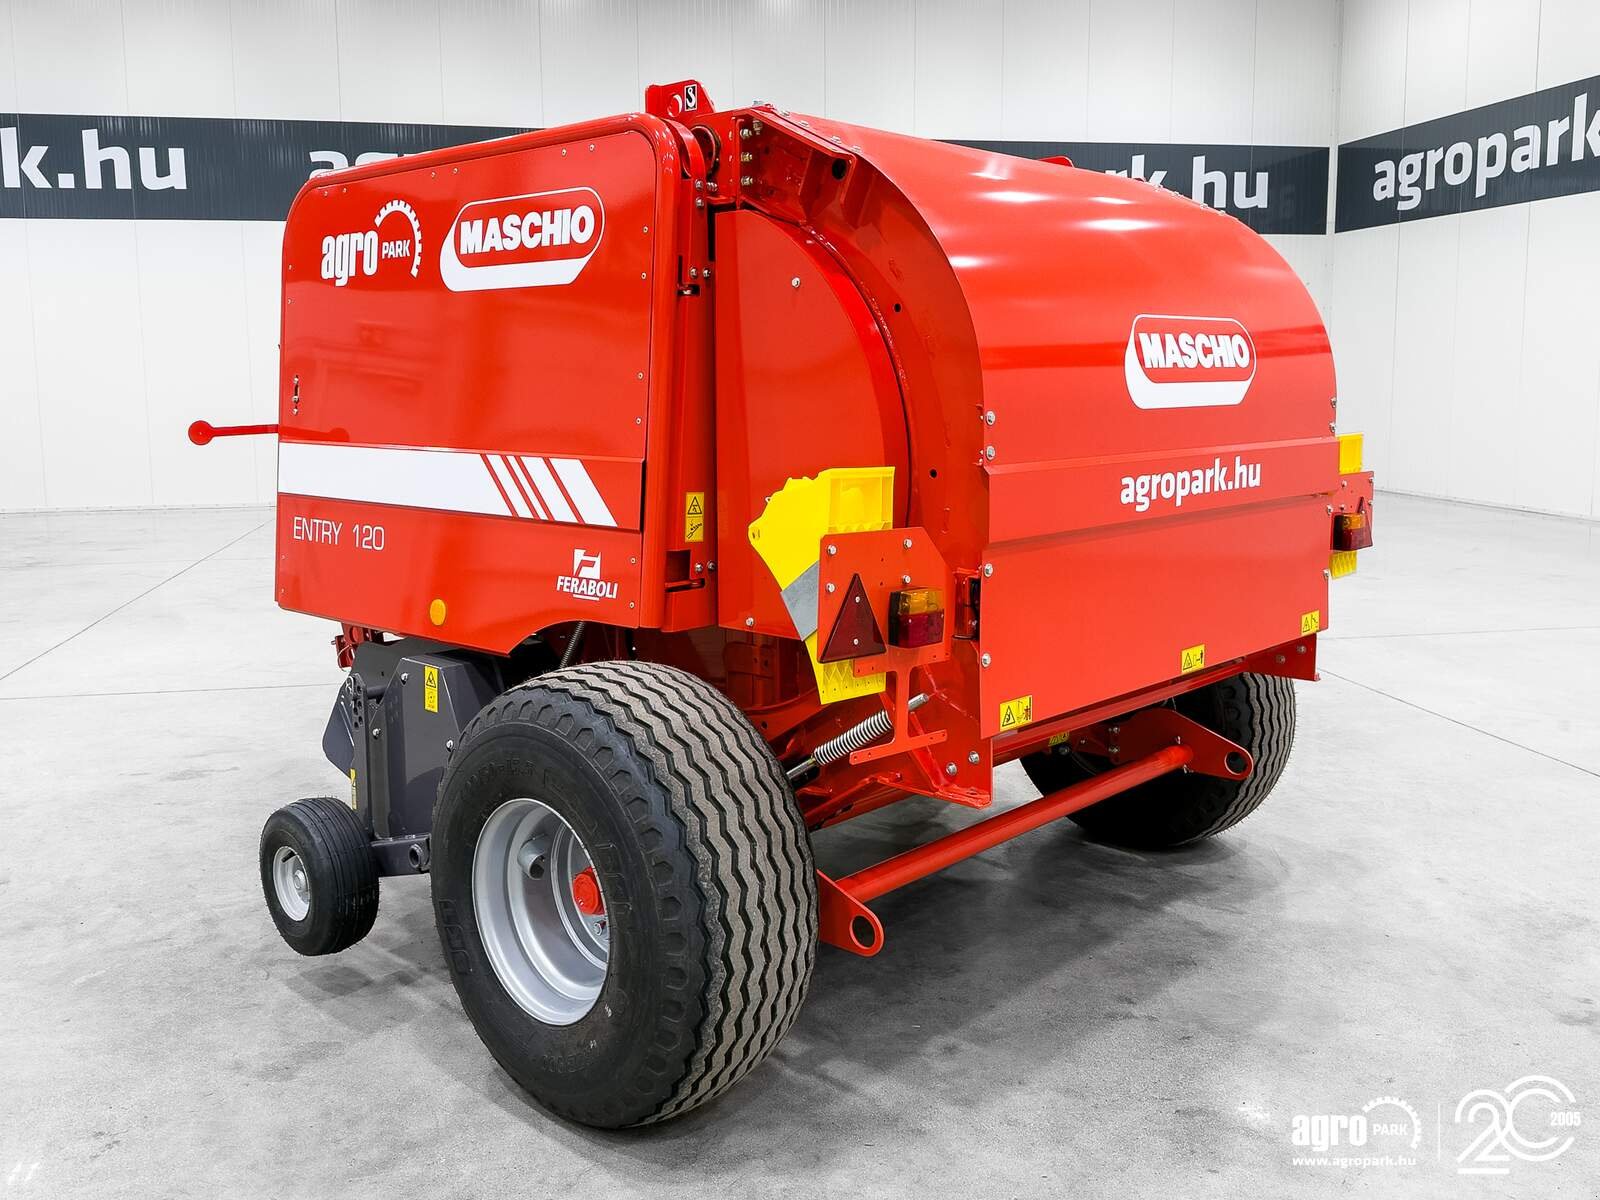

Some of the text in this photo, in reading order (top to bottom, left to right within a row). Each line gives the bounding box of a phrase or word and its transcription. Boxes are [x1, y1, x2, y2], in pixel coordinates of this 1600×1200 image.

[0, 127, 188, 191] k.hu
[1373, 93, 1600, 211] agropark
[460, 205, 595, 256] MASCHIO
[321, 229, 410, 287] agro PARK
[1139, 333, 1250, 369] MASCHIO
[1120, 456, 1262, 512] agropark.hu
[293, 516, 385, 551] ENTRY 120
[556, 575, 618, 599] FERABOLI
